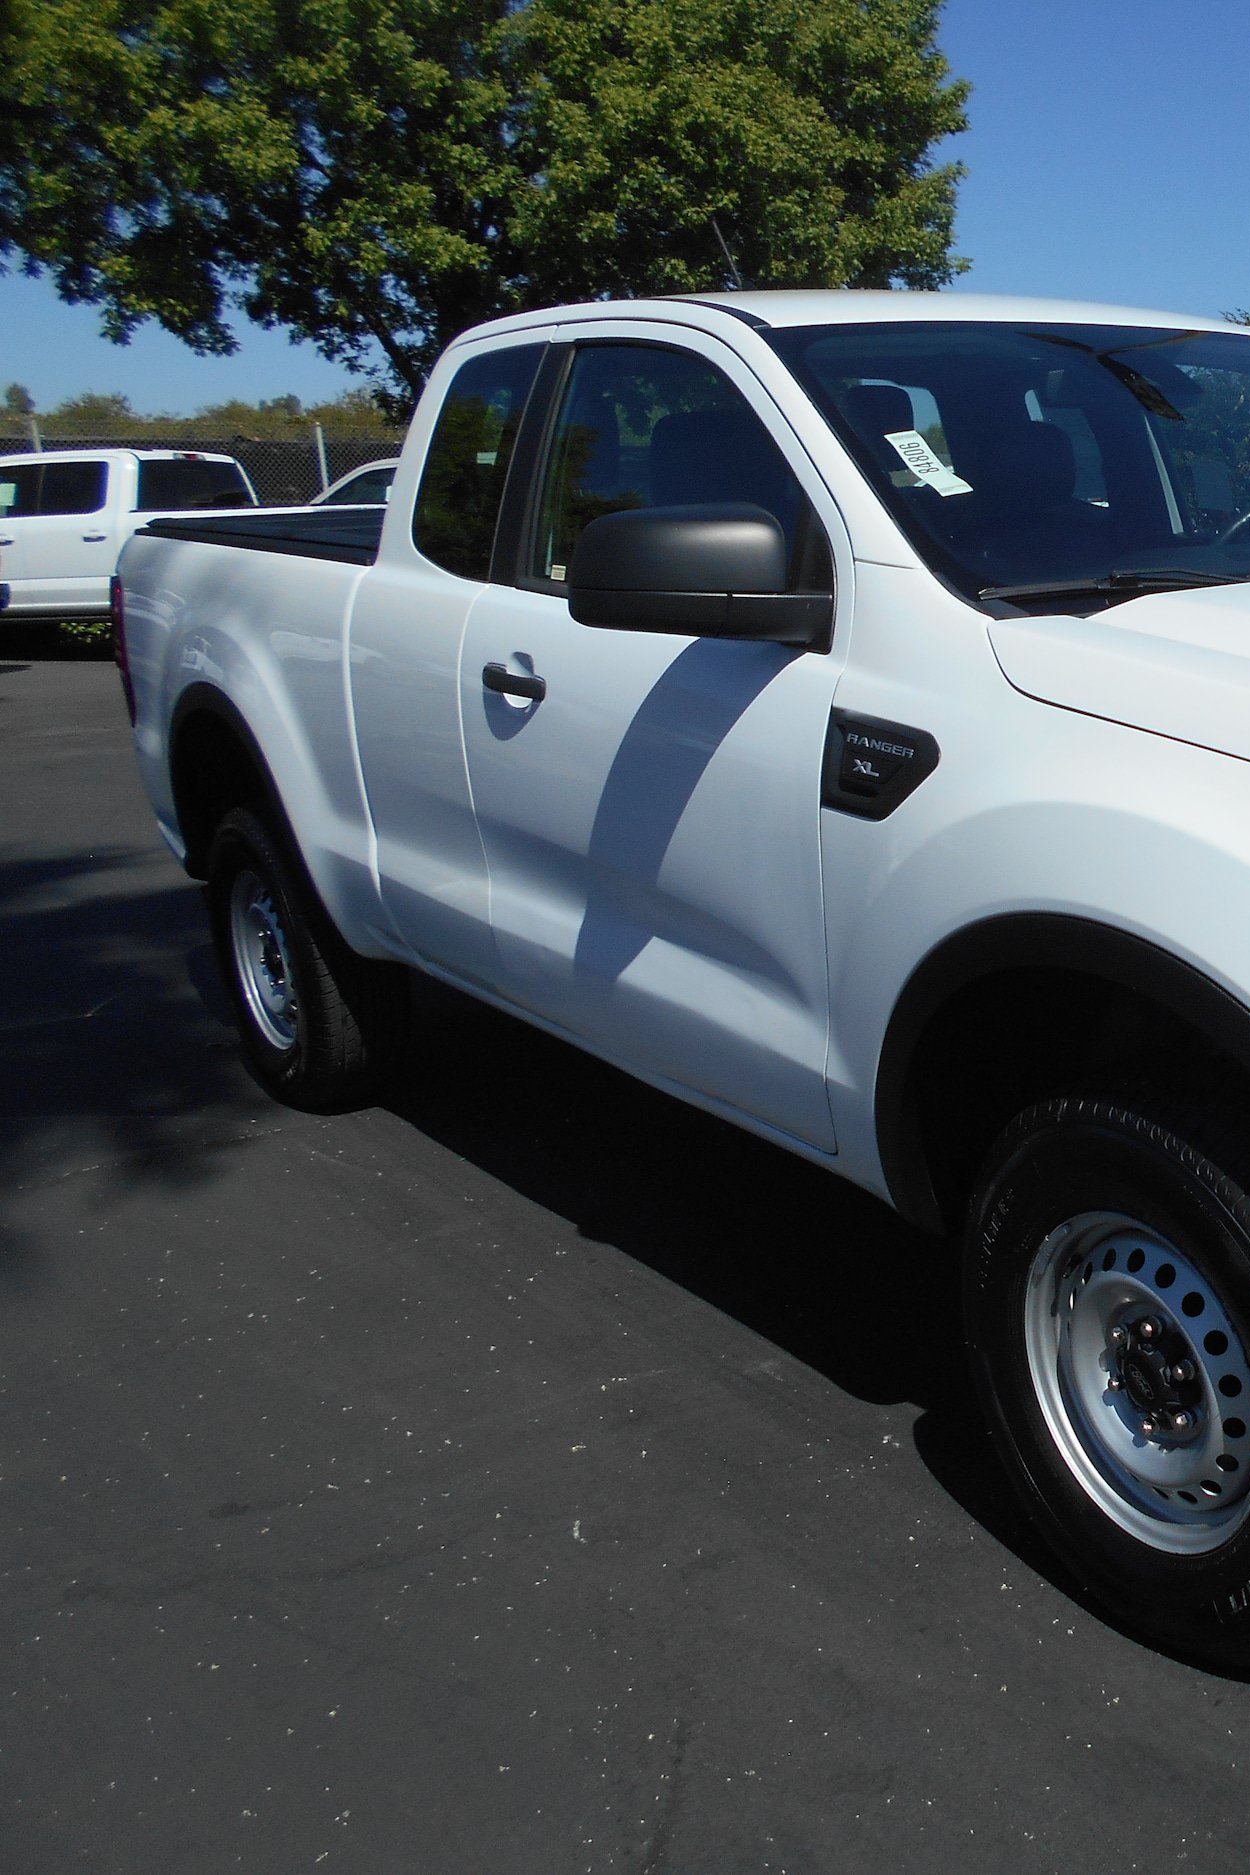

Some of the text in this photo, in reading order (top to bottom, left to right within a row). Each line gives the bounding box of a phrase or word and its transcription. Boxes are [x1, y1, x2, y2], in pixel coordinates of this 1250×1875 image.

[899, 442, 940, 474] 84806
[846, 732, 915, 759] RANGER
[852, 758, 880, 778] XL
